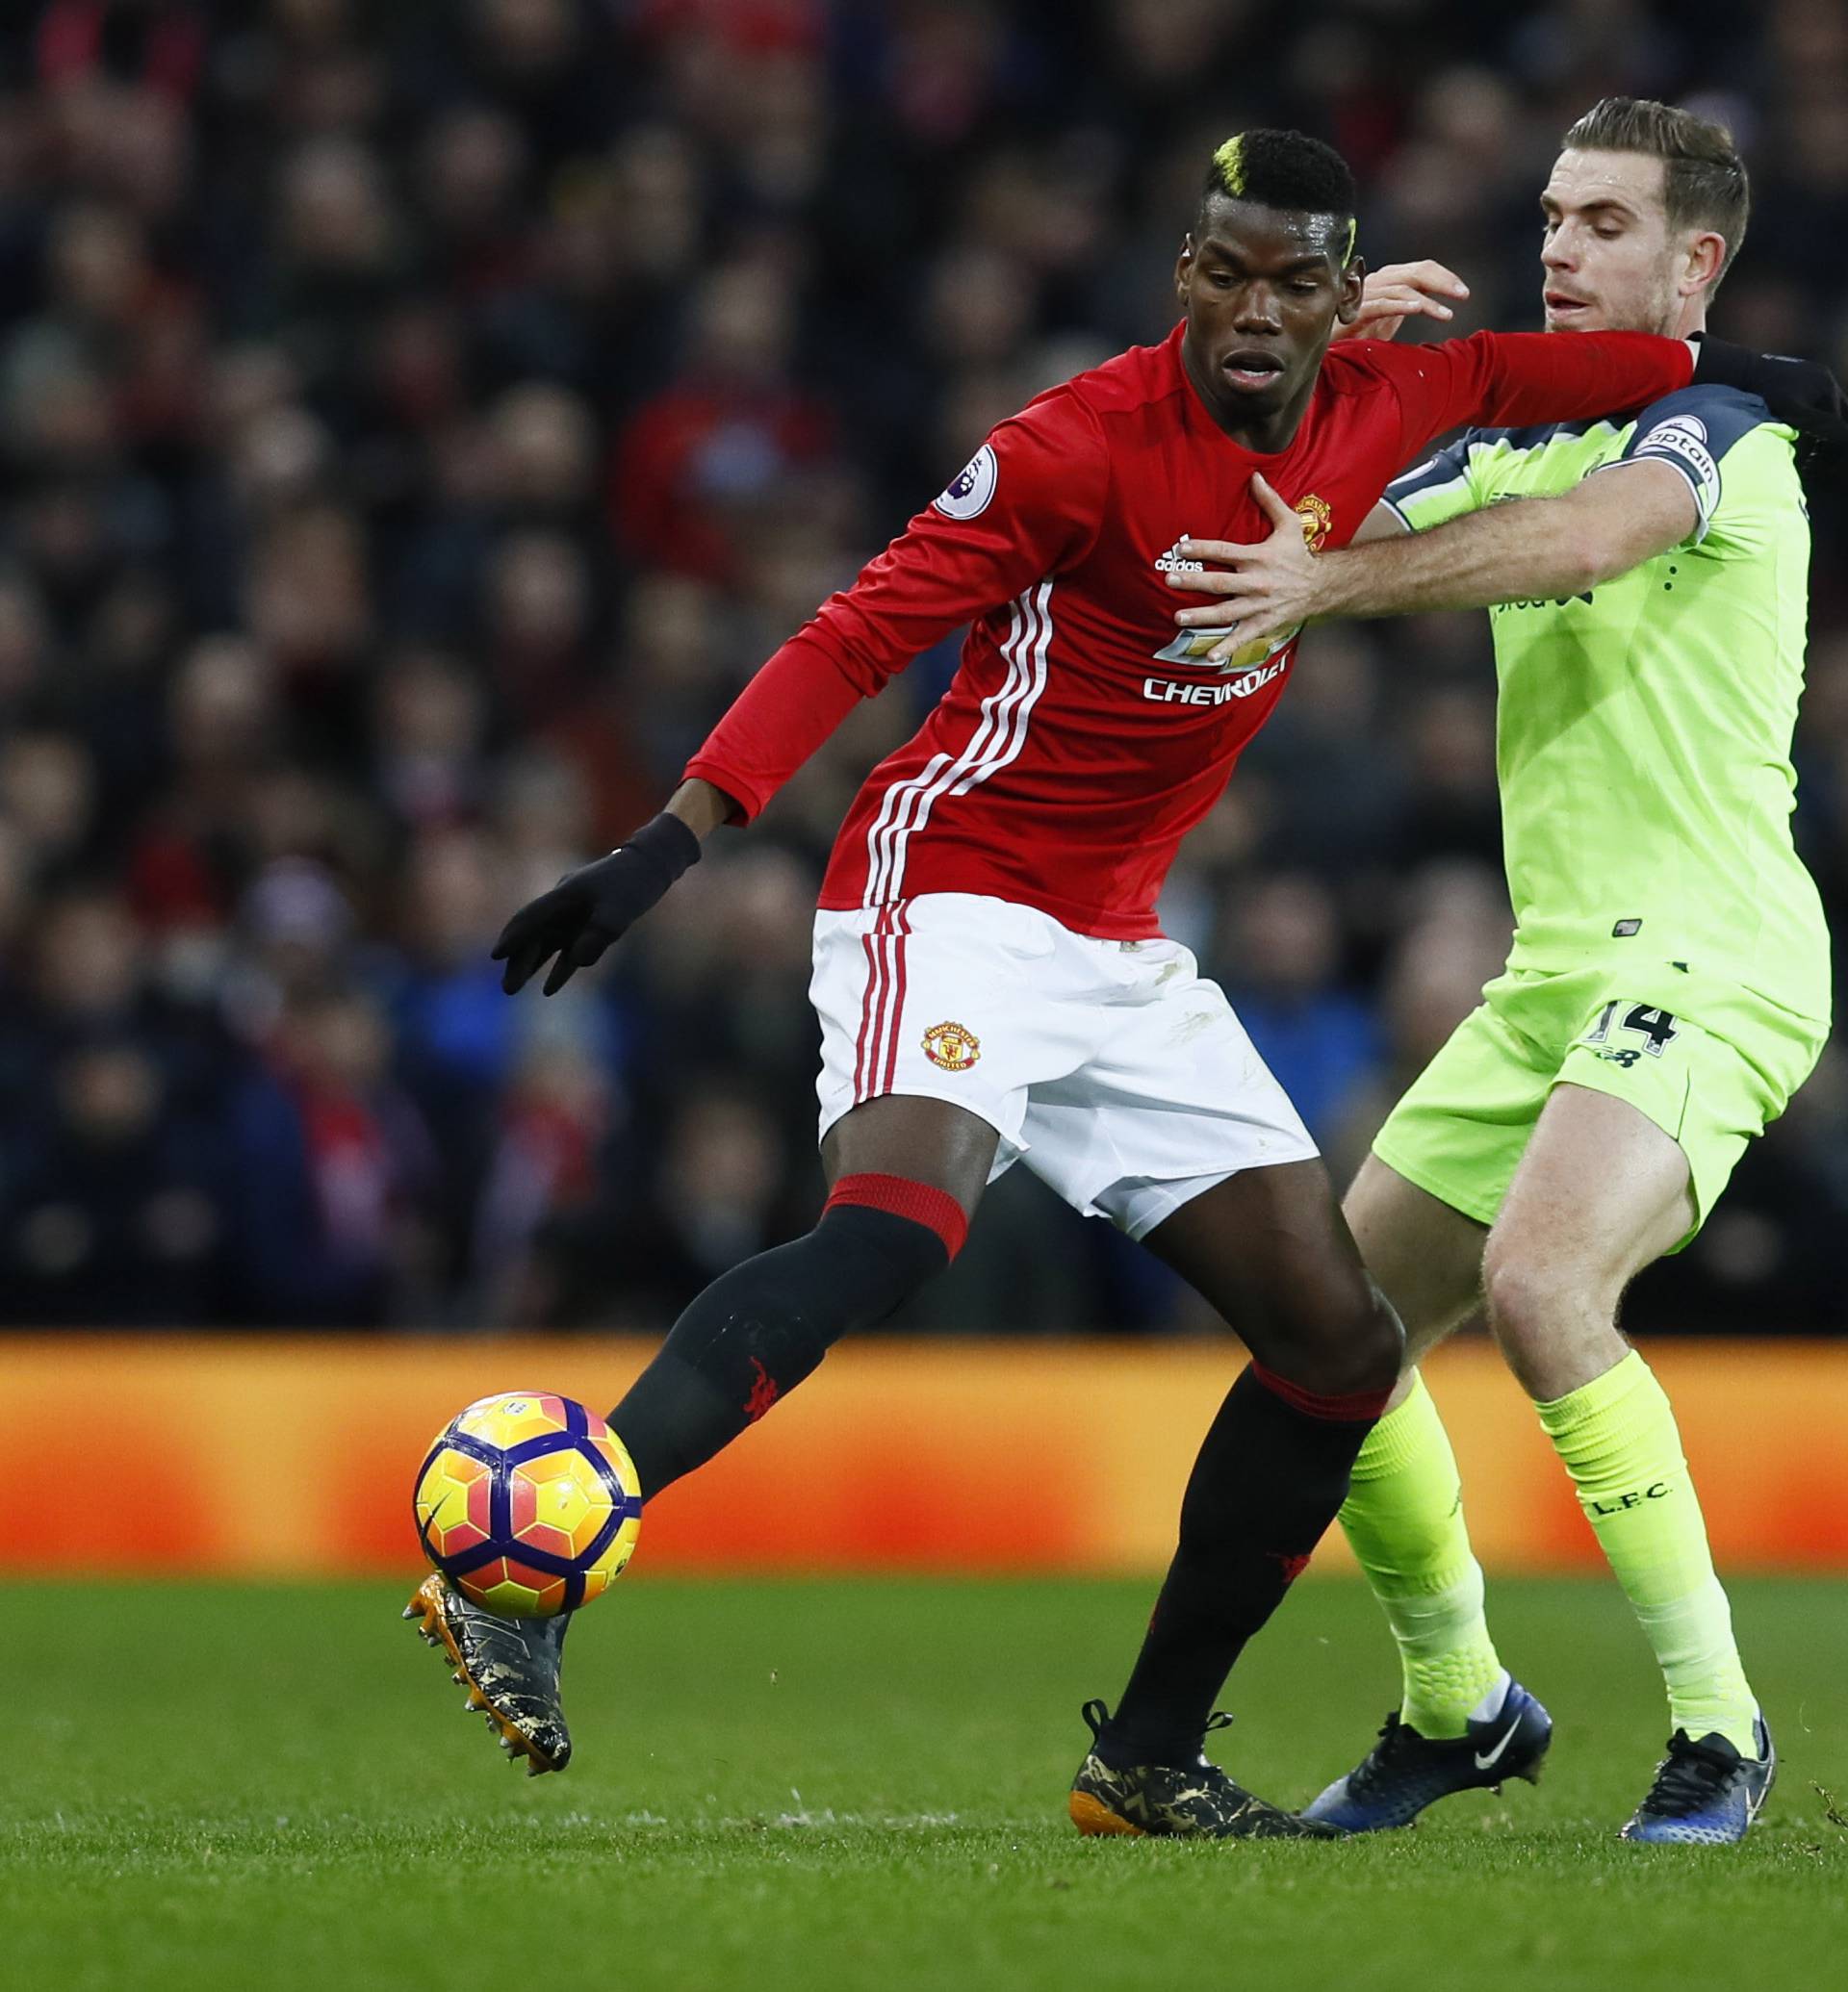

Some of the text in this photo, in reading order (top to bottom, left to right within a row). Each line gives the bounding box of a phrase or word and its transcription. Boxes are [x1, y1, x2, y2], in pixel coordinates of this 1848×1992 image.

[1647, 433, 1713, 483] aptain
[1155, 558, 1203, 572] adidas
[1143, 649, 1291, 705] CHEVROLET
[1582, 1000, 1680, 1058] 14
